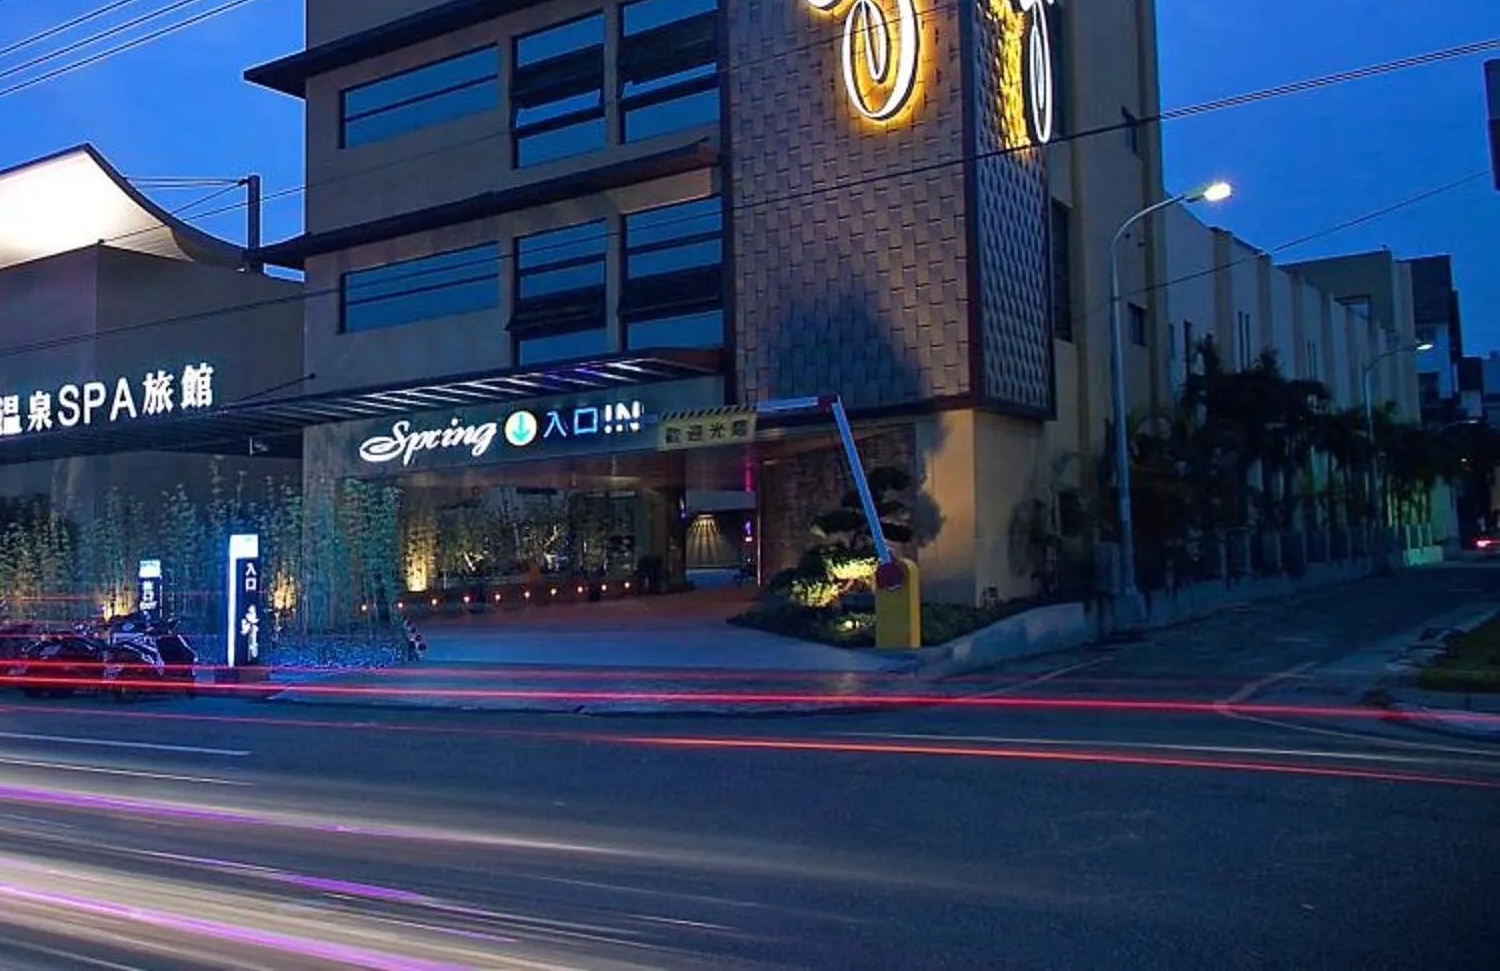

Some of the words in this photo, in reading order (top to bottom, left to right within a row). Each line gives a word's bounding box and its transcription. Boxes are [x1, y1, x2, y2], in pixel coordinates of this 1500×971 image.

[544, 407, 598, 438] 入口
[359, 417, 498, 467] Spring
[244, 562, 257, 591] 入口
